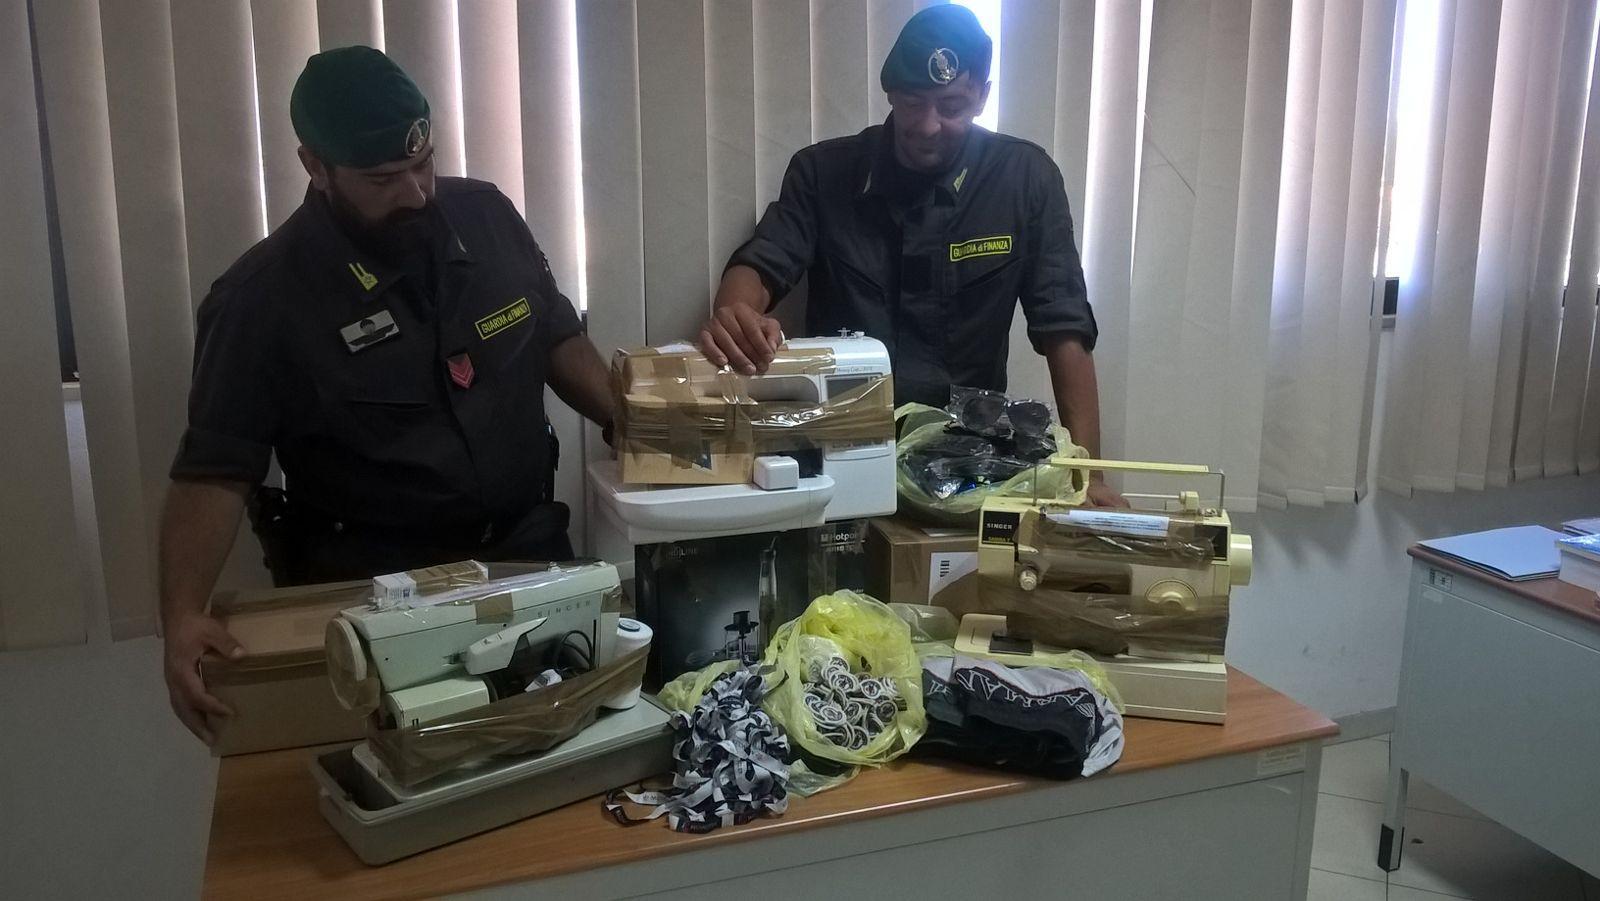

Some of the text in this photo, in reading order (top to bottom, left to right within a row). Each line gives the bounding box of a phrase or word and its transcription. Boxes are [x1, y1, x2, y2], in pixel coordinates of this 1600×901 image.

[984, 240, 1008, 251] FINANZA
[481, 314, 508, 333] GUARDIA
[537, 600, 591, 618] SINGER
